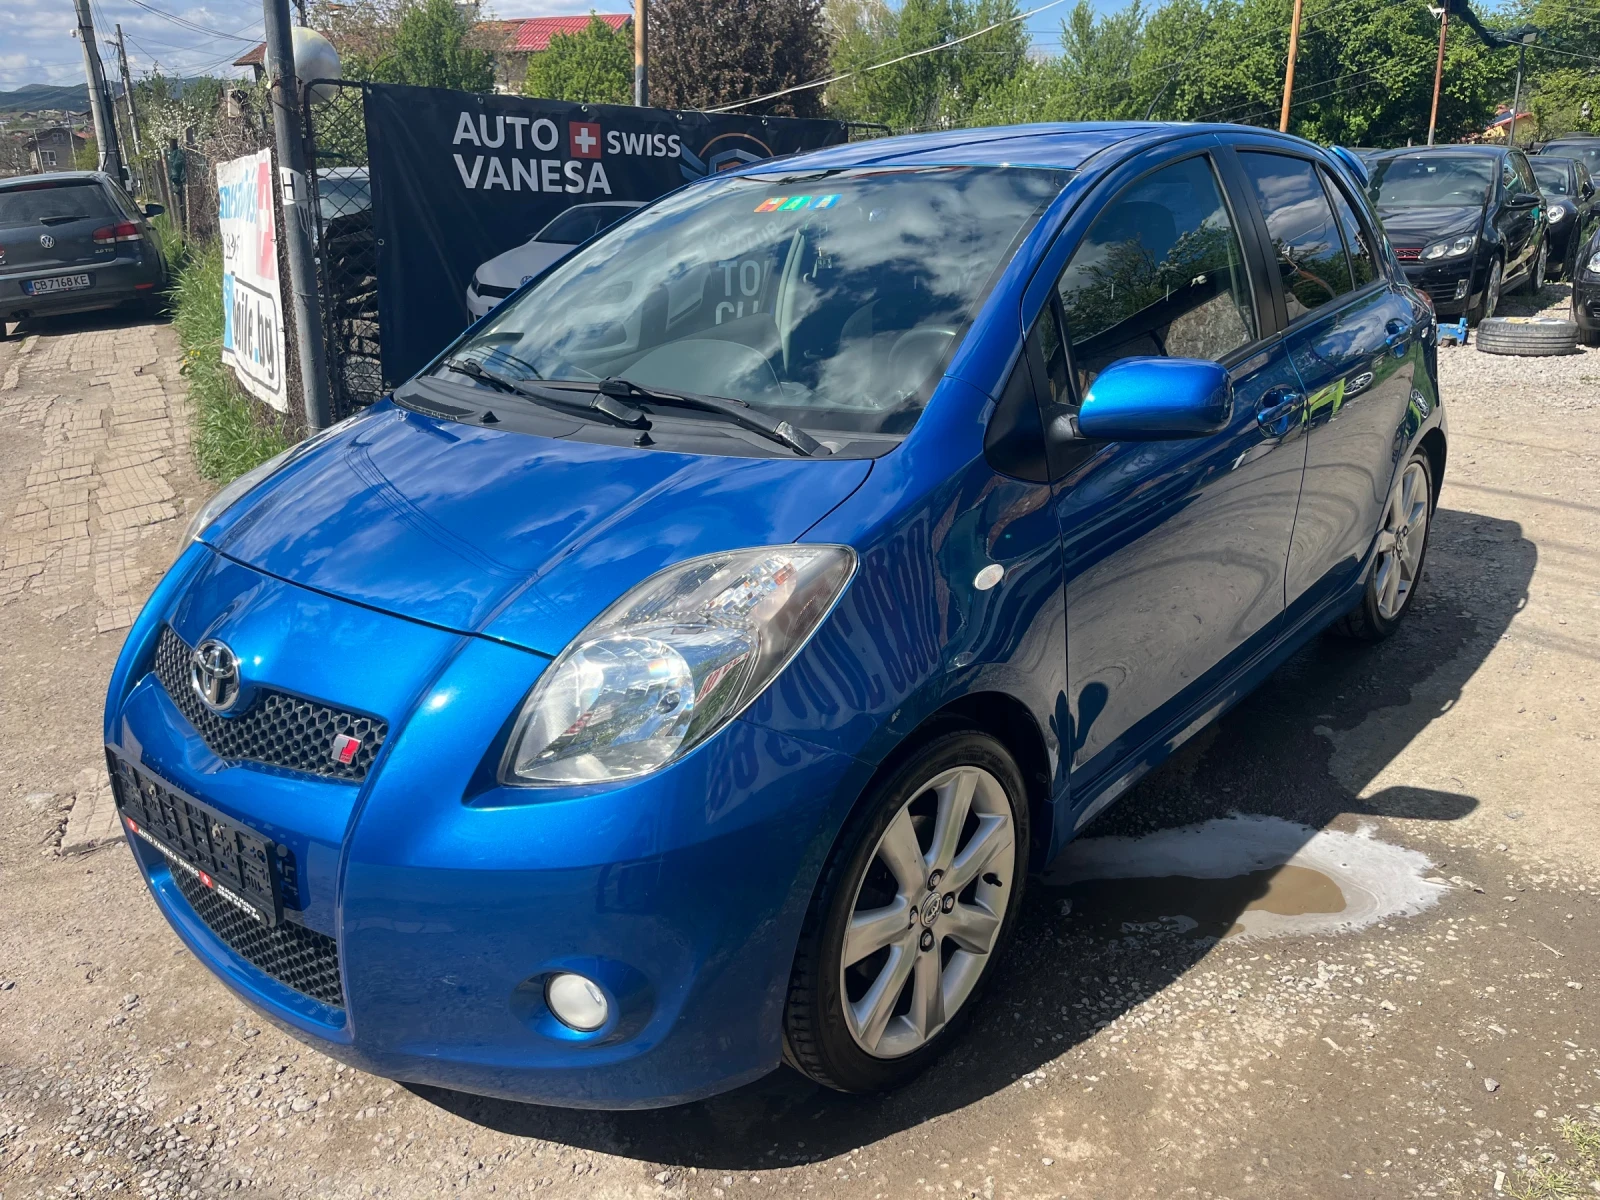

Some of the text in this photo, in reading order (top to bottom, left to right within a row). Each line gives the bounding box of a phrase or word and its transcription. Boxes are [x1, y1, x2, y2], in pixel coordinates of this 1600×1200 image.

[453, 111, 681, 158] AUTO SWISS
[453, 153, 612, 195] VANESA
[718, 259, 770, 297] TO
